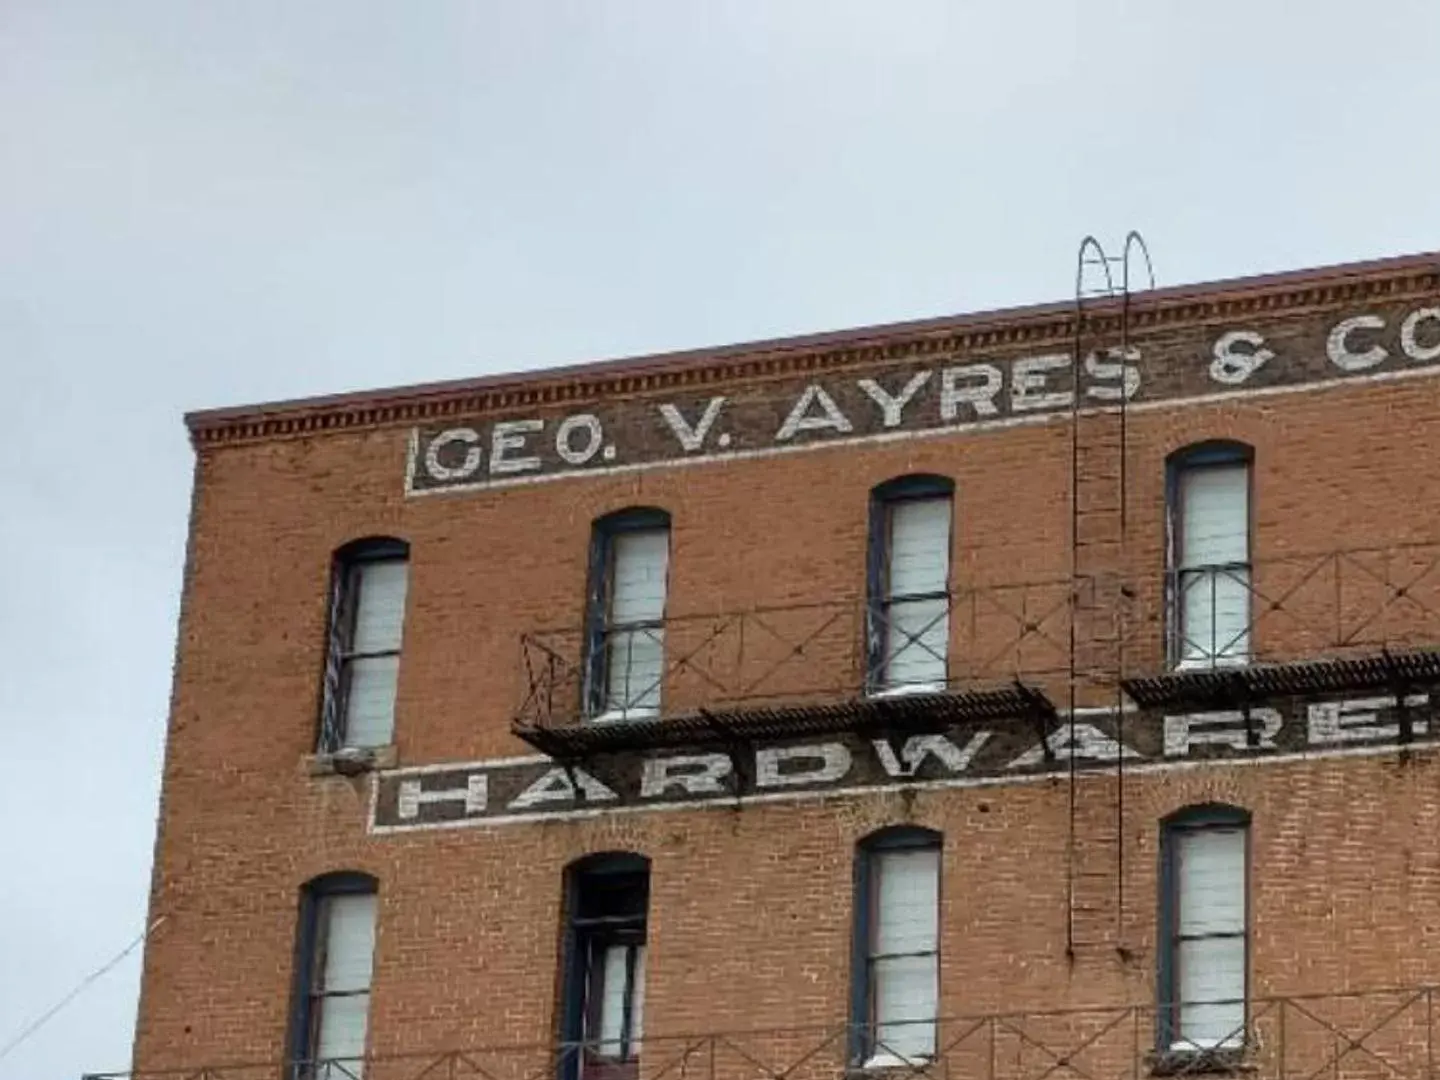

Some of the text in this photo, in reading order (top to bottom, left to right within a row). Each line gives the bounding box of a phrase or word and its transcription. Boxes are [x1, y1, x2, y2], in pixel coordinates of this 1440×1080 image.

[424, 413, 617, 480] GEO.
[659, 397, 731, 451] V.
[776, 345, 1142, 440] AYRES
[1208, 330, 1275, 385] &
